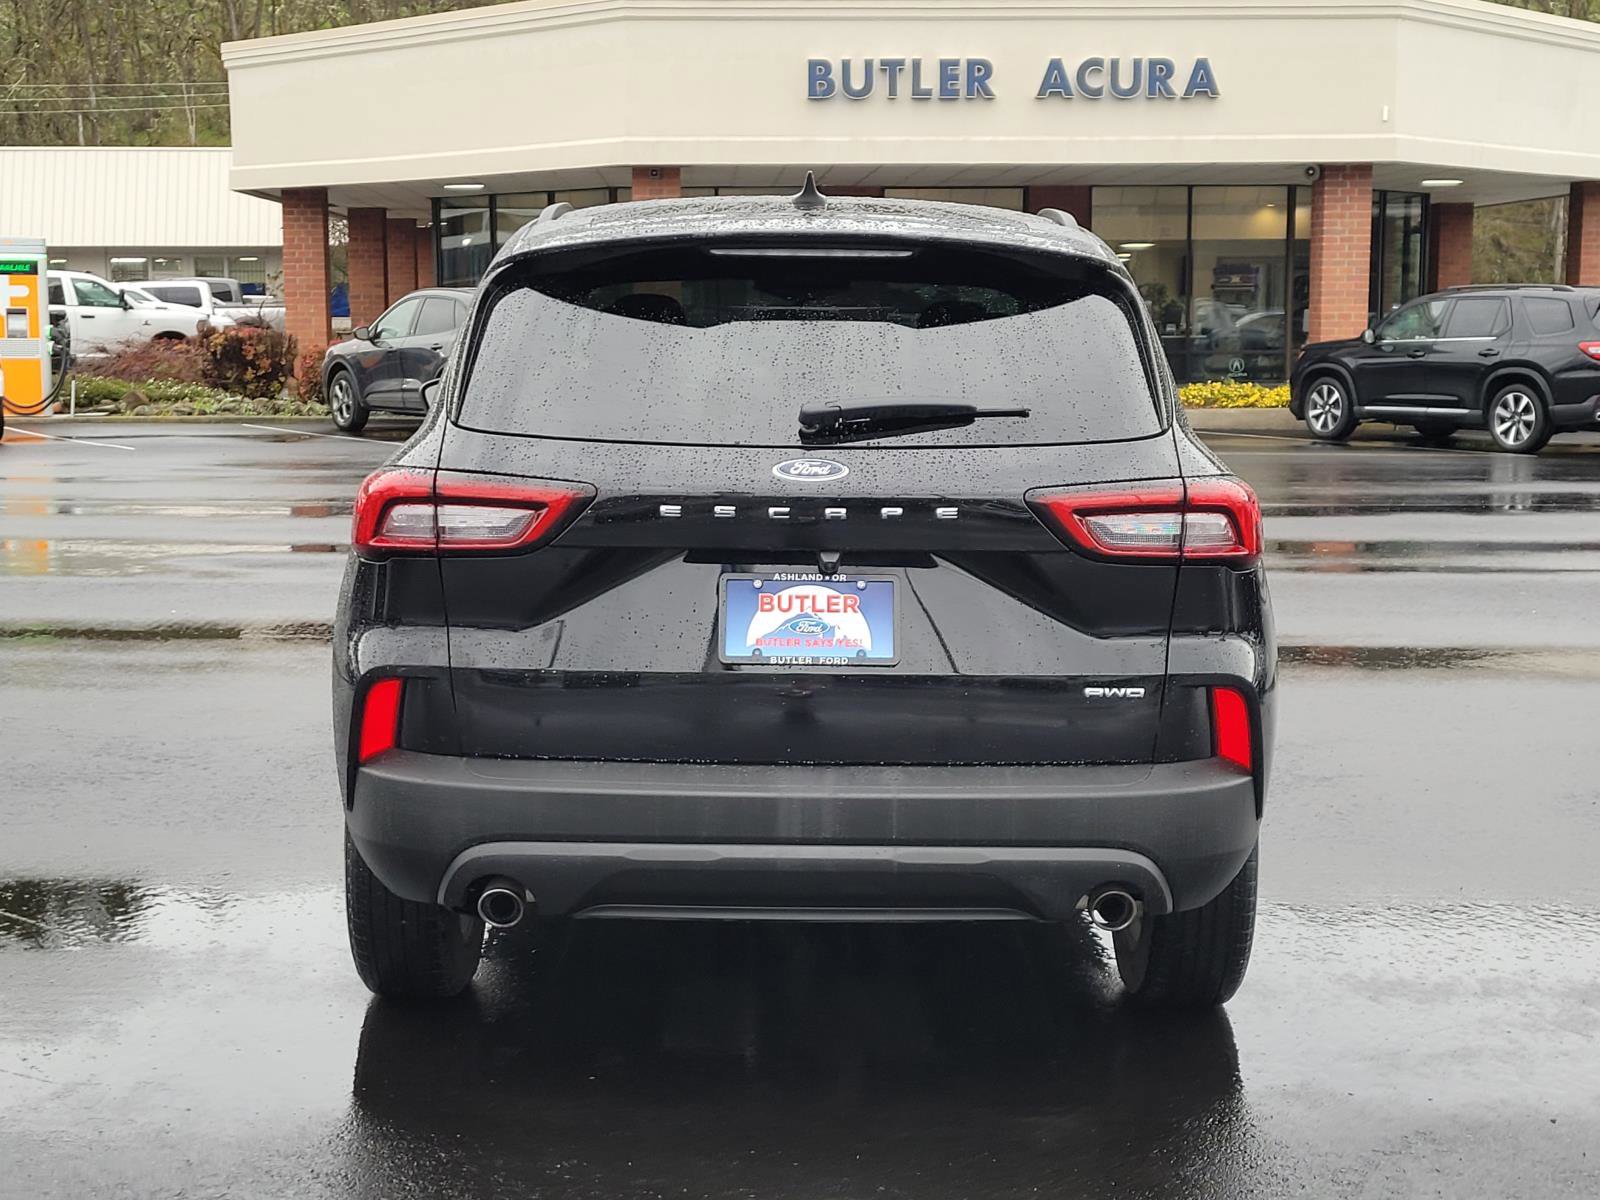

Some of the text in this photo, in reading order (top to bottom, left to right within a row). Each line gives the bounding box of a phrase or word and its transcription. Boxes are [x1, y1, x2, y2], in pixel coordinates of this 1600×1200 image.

[807, 57, 1221, 99] BUTLER ACURA
[659, 504, 959, 519] ESCAPE
[773, 573, 847, 582] ASHLAND OR
[759, 593, 860, 614] BUTLER
[755, 637, 864, 648] BUTLER SAYS YES!
[770, 656, 849, 665] BUTLER FORD
[1084, 687, 1146, 698] AWD
